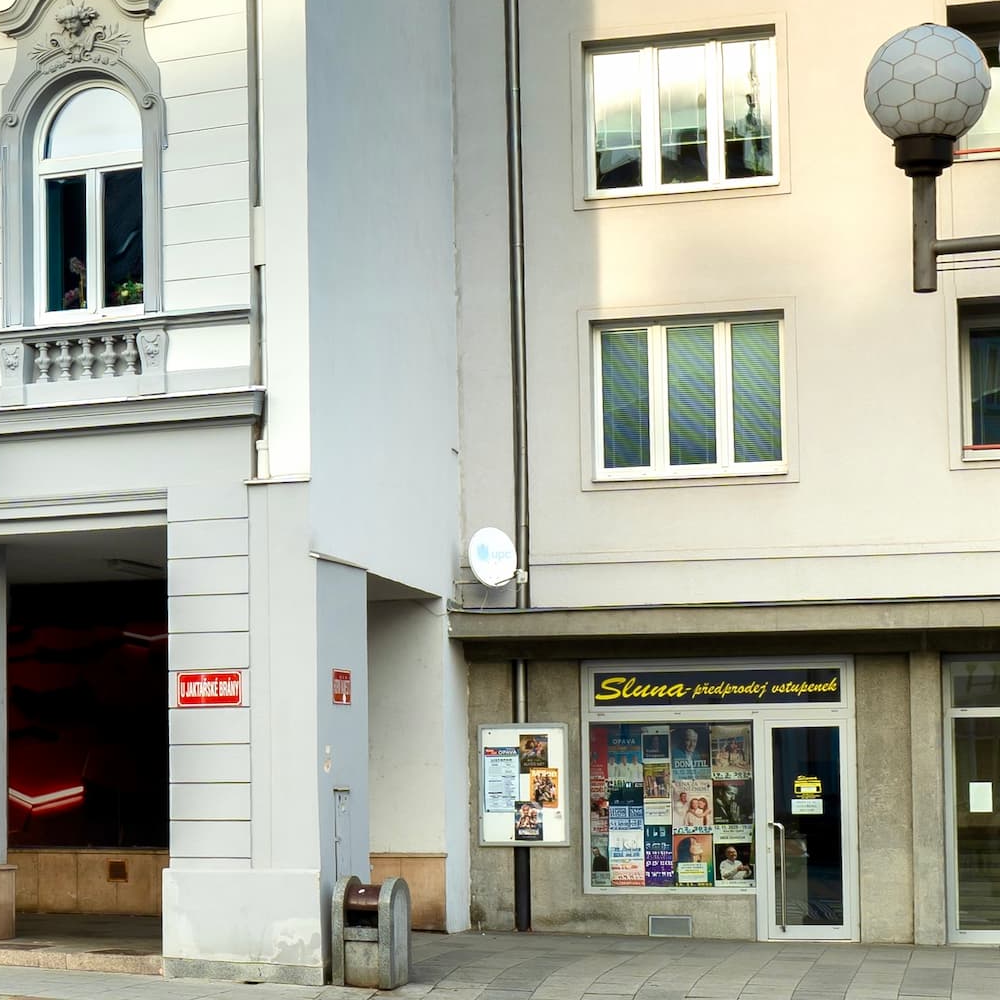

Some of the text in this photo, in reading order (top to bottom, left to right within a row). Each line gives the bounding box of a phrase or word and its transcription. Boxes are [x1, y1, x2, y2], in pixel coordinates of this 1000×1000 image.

[491, 551, 512, 561] upc
[181, 677, 239, 697] U JAKTAŘSKÉ BRÁNY
[772, 678, 838, 697] vstupenek
[674, 760, 708, 768] DONUTIL
